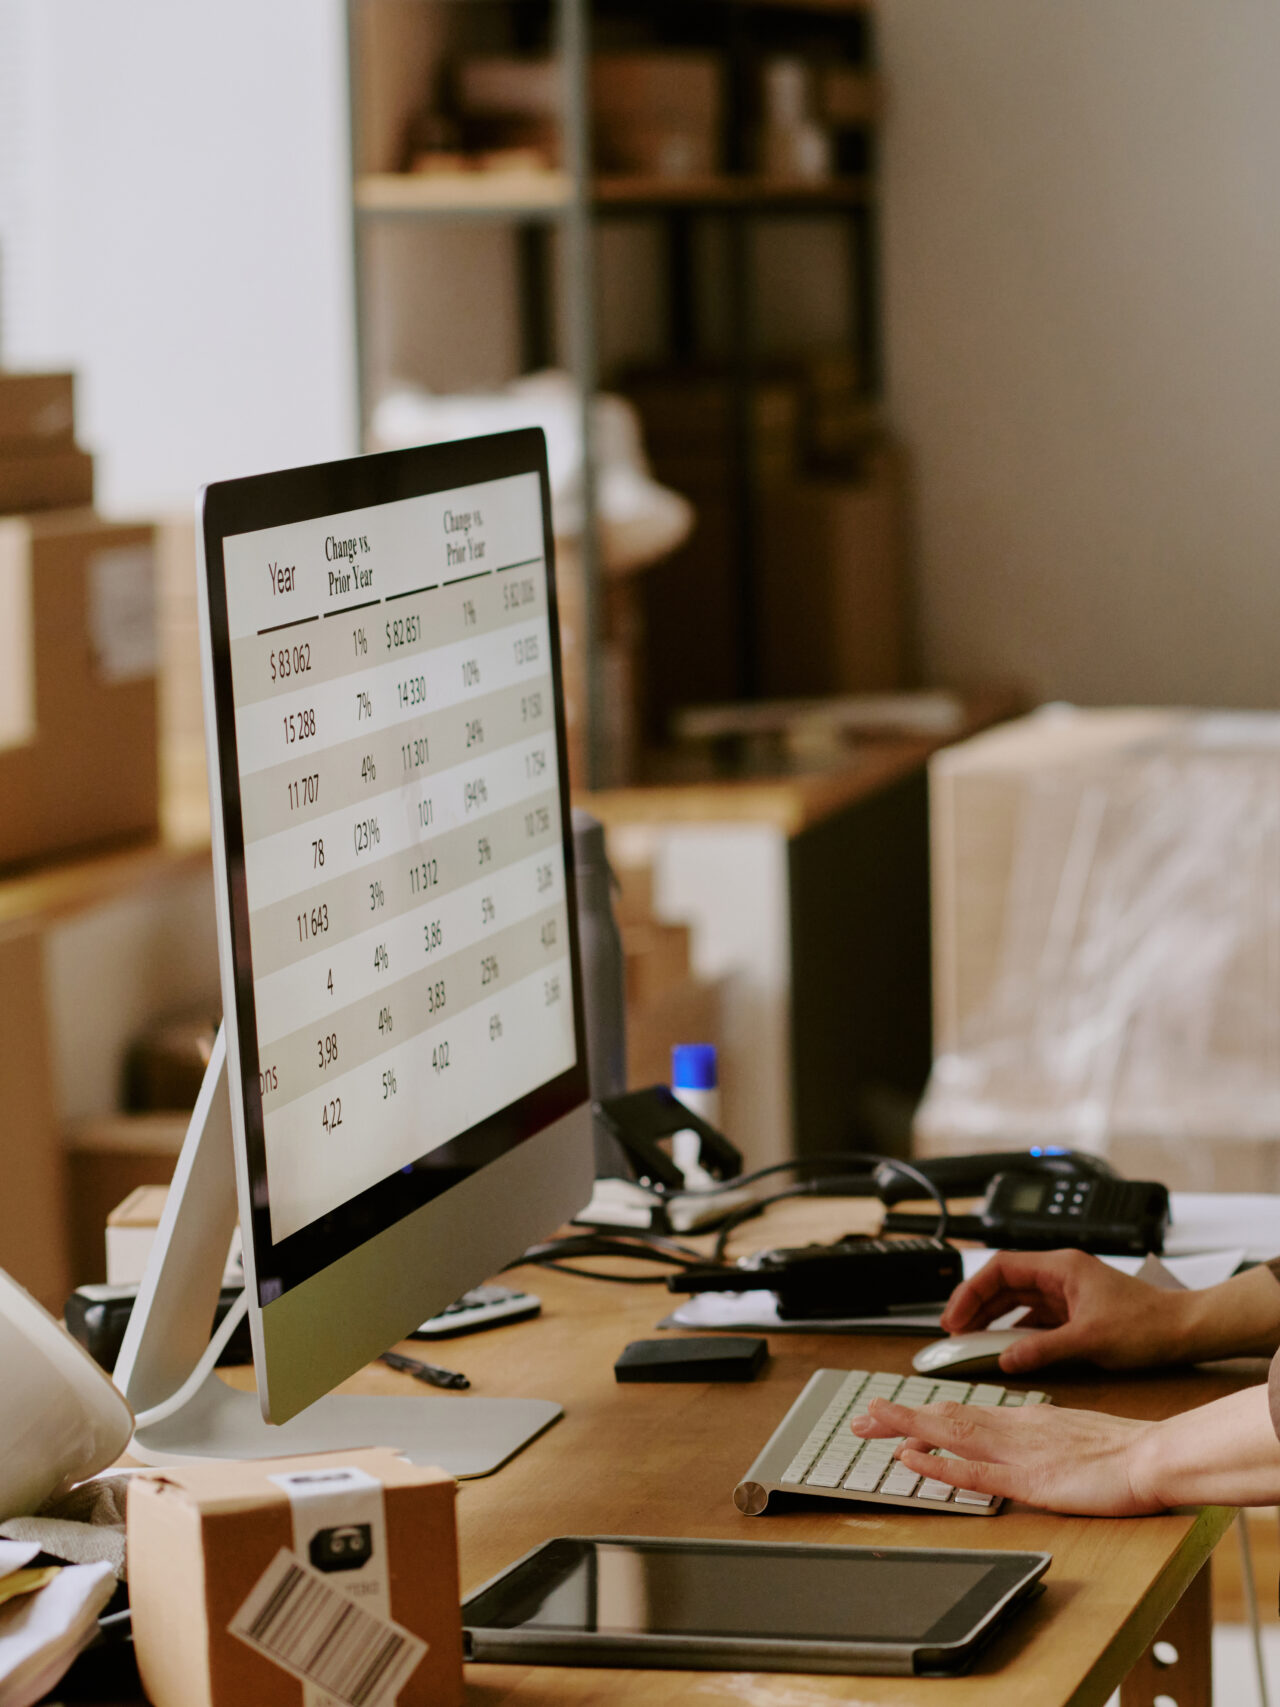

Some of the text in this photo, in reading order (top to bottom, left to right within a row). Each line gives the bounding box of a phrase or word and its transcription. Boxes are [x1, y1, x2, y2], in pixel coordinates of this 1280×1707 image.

[443, 510, 472, 536] Change
[325, 536, 370, 563] Change vs.
[446, 538, 486, 566] Prior Year
[268, 562, 296, 595] Year
[328, 565, 373, 596] Prior Year
[353, 628, 368, 656] 1%
[356, 691, 372, 720] 7%
[465, 718, 484, 748] 24%
[361, 754, 376, 783] 4%
[418, 798, 434, 828] 101
[354, 816, 380, 856] (23)%
[312, 838, 325, 869] 78
[370, 880, 385, 912] 3%
[424, 920, 442, 954] 3,86
[374, 943, 389, 973] 4%
[327, 968, 334, 996] 4
[428, 980, 446, 1015] 3,83
[378, 1006, 393, 1036] 4%
[318, 1032, 338, 1071] 3,98
[432, 1041, 450, 1077] 4,02
[382, 1068, 397, 1100] 5%
[322, 1097, 343, 1136] 4,22
